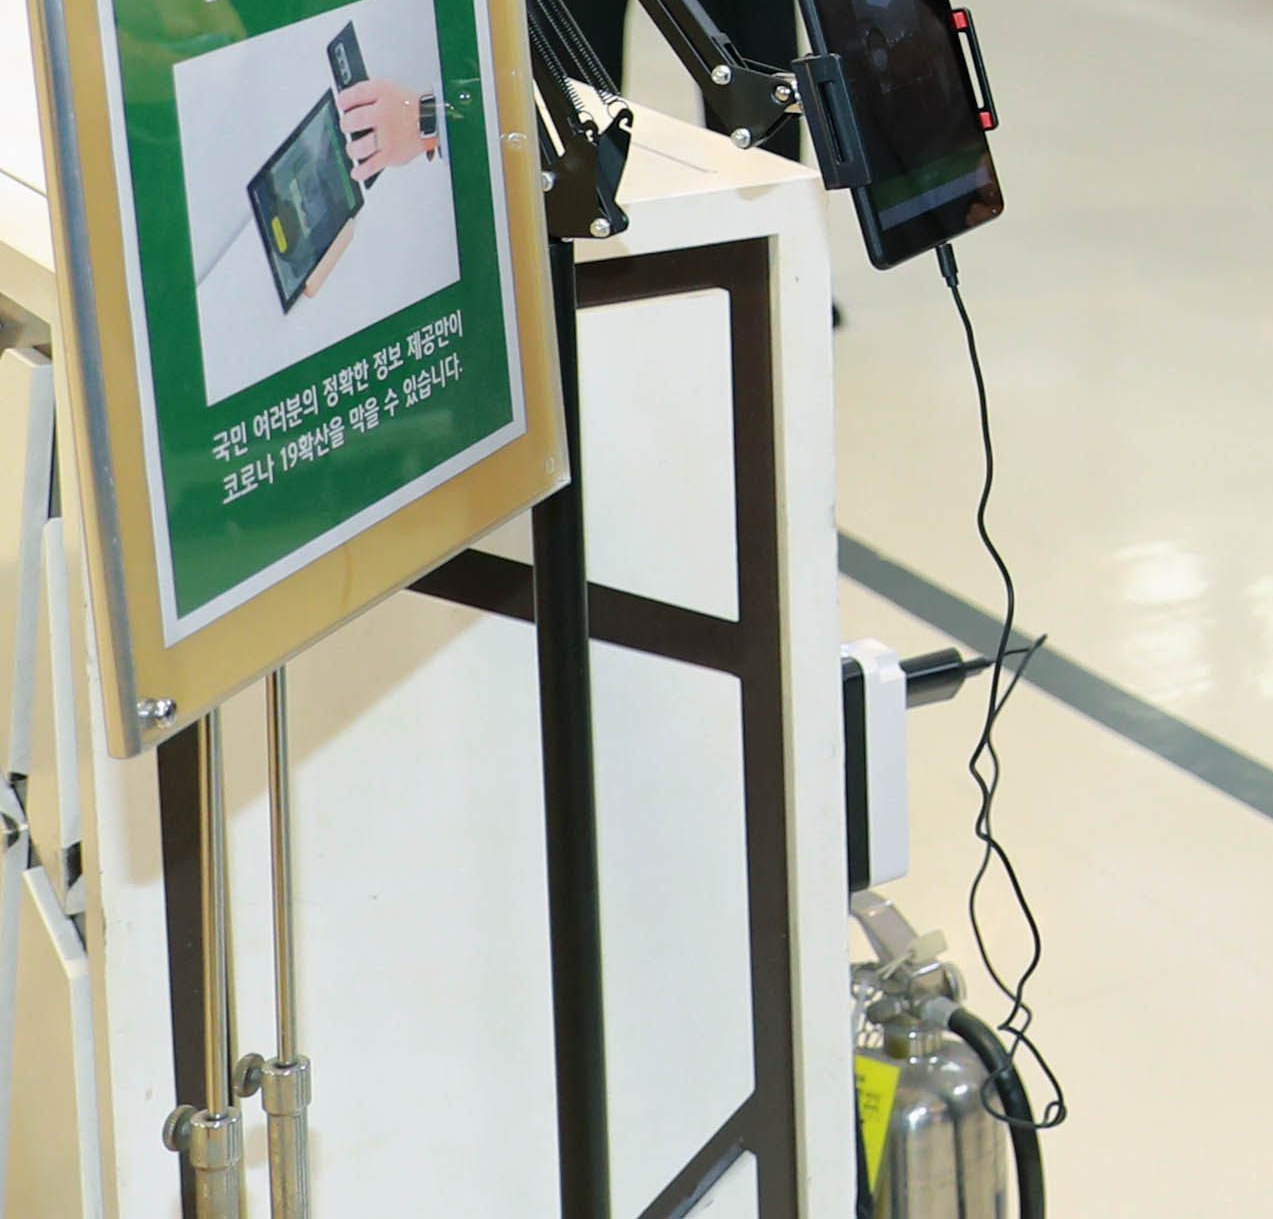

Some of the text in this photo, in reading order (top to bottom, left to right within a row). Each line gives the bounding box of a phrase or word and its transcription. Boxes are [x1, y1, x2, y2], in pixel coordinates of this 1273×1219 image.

[211, 309, 463, 461] 국민 여러분의 정확한 정보 제공만이
[222, 352, 463, 505] 코로나 19확산을 막을 수 있습니다.
